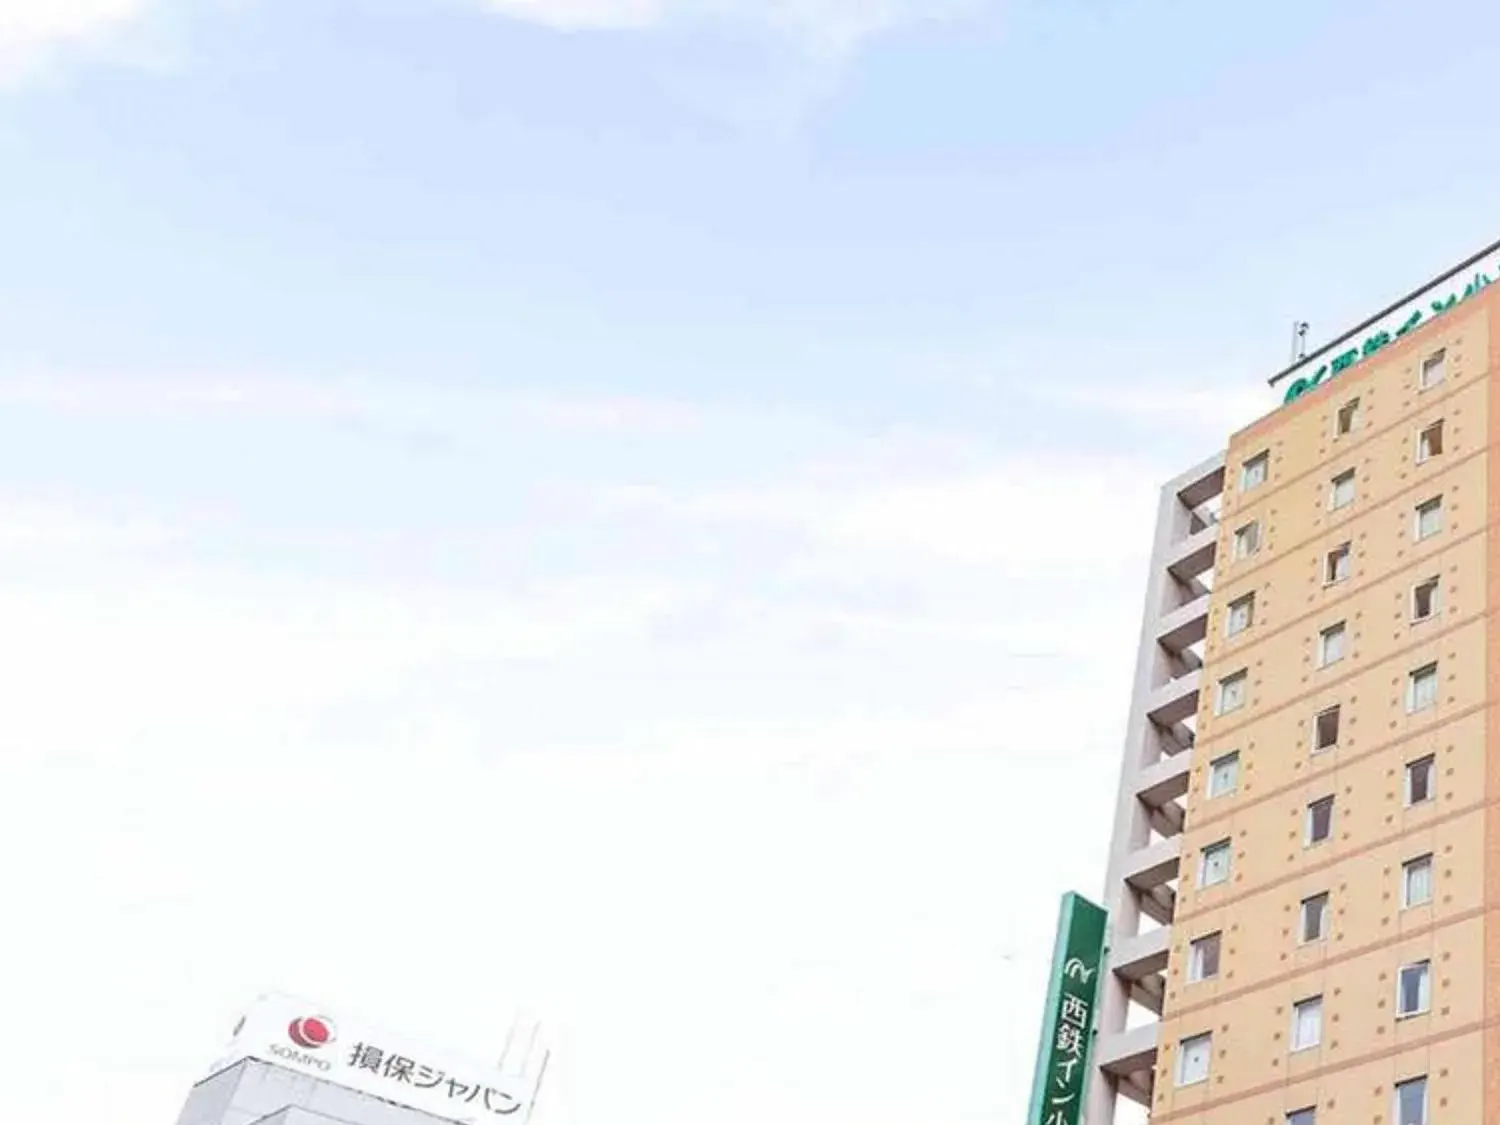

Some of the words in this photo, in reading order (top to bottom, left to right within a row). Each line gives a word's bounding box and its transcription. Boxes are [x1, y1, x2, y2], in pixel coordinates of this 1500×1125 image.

[269, 1042, 332, 1073] SOMPO
[348, 1041, 521, 1115] 損保ジャパン
